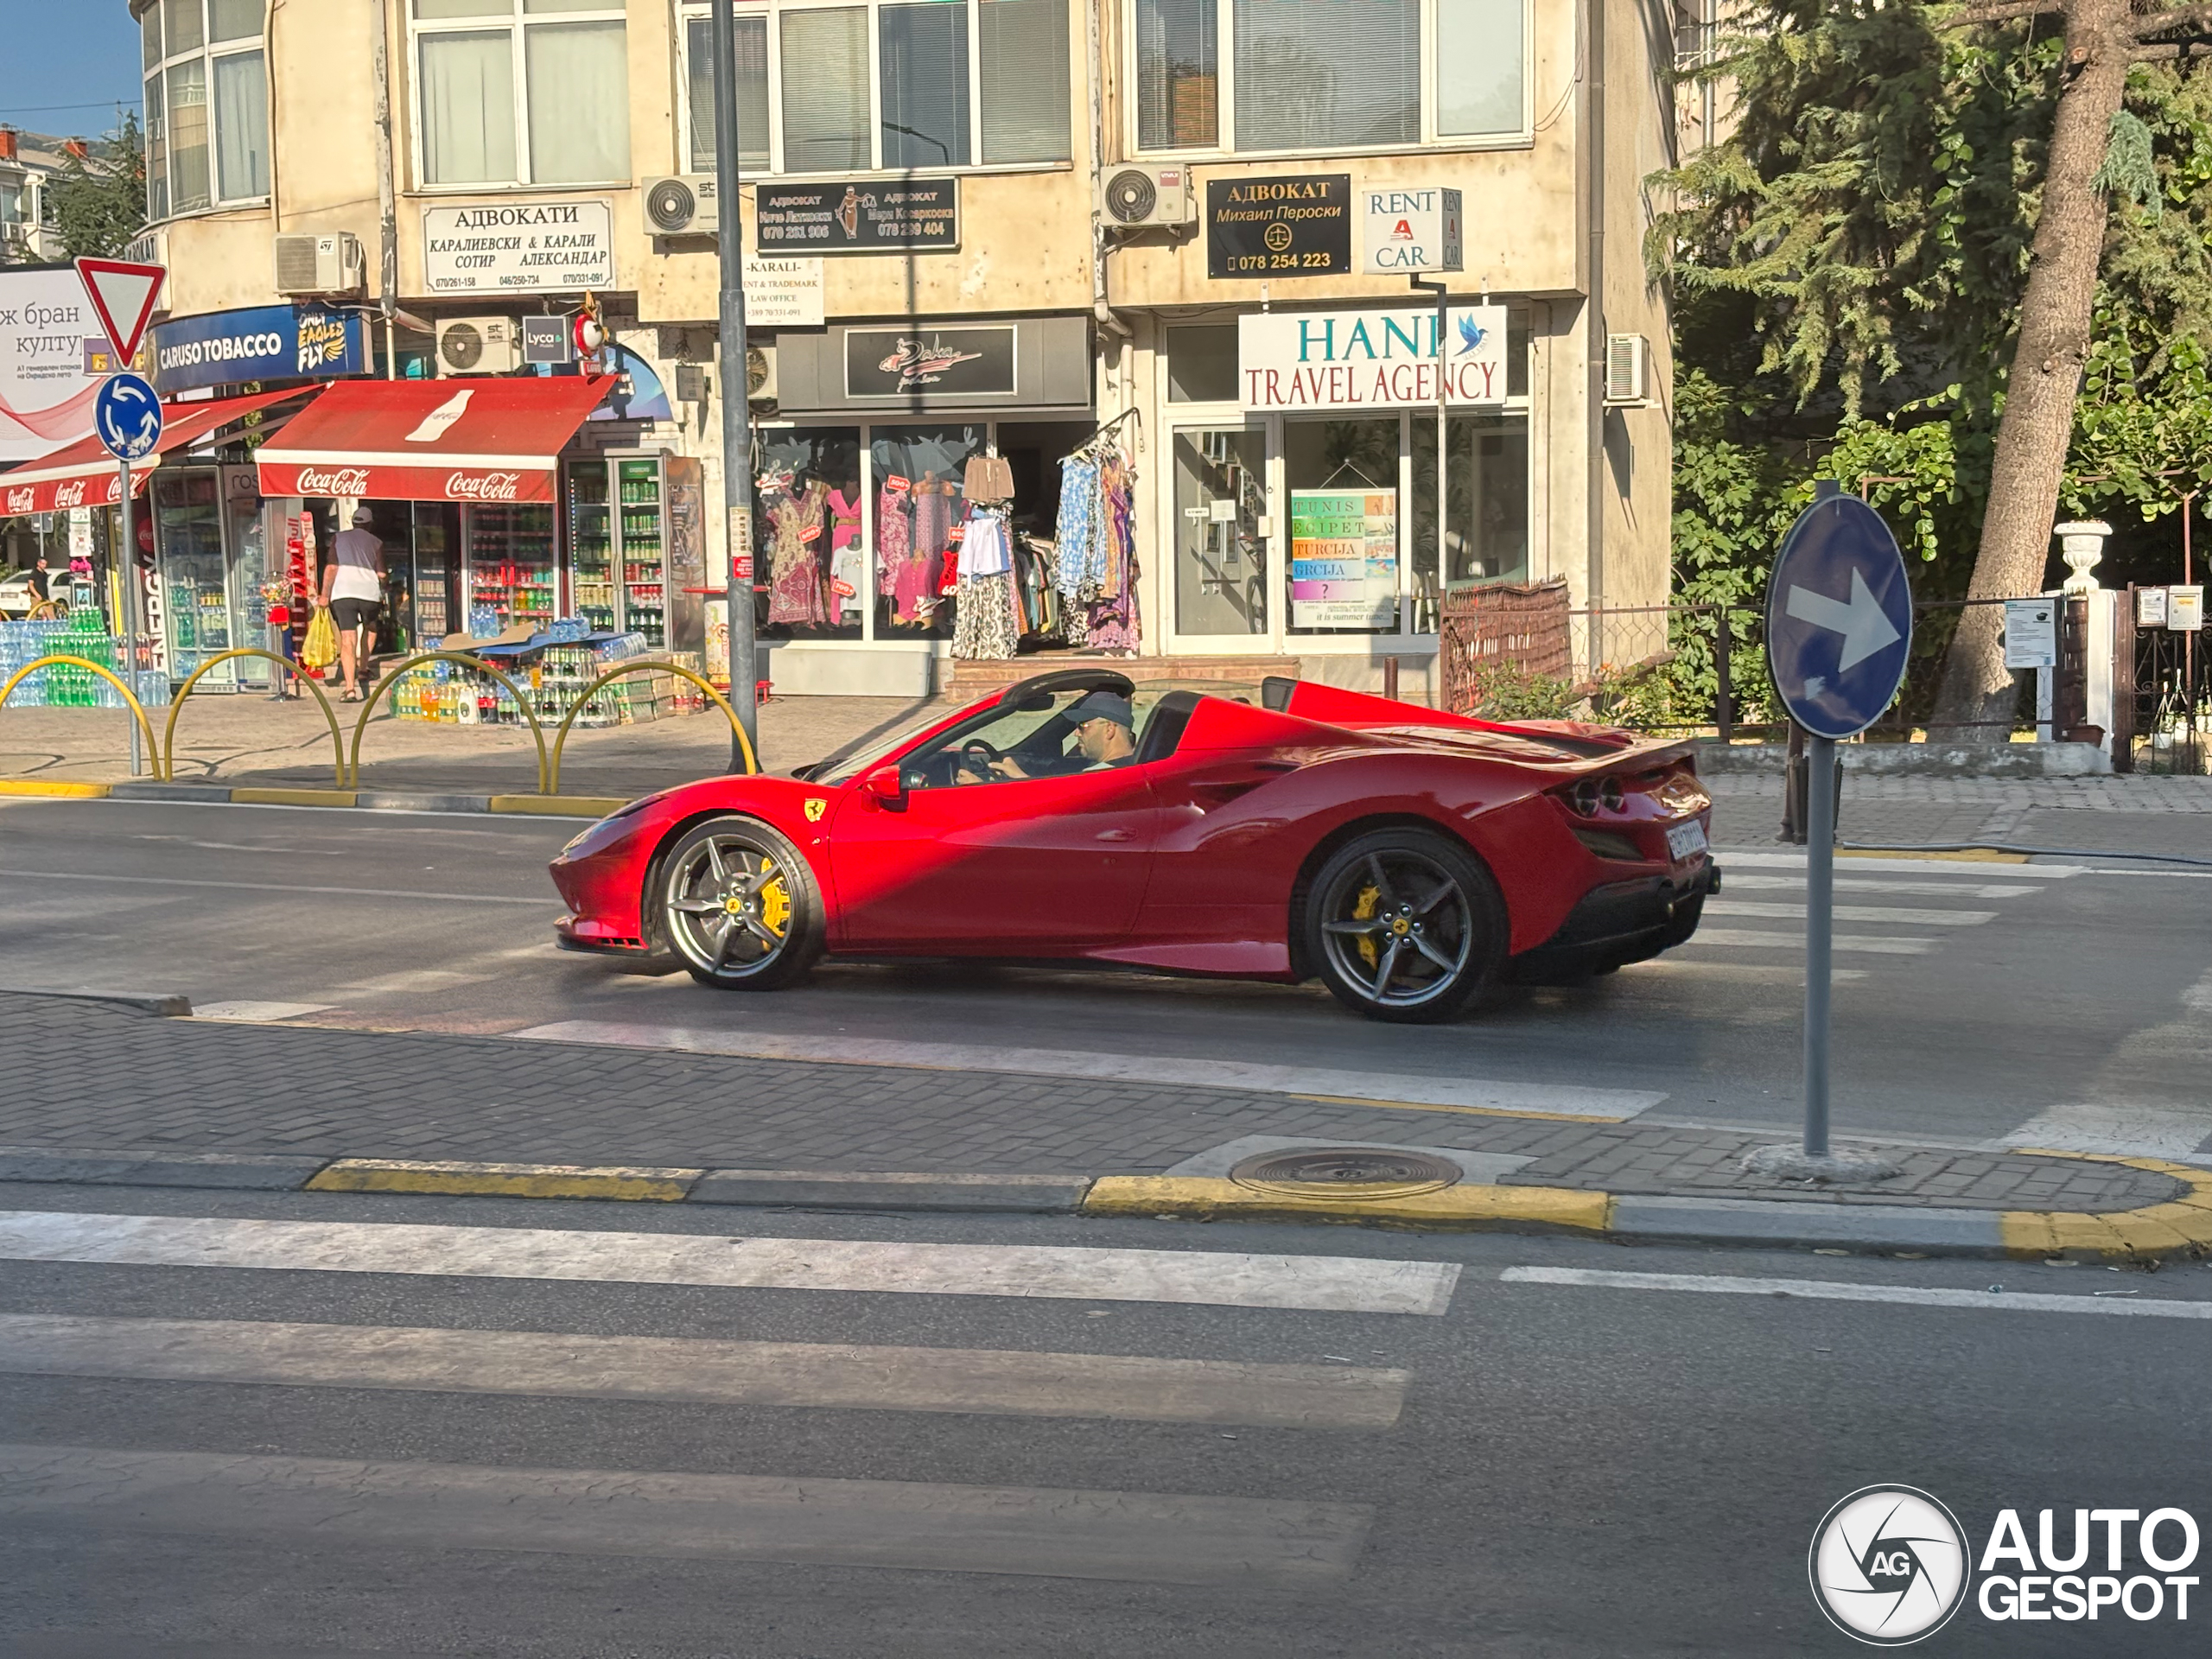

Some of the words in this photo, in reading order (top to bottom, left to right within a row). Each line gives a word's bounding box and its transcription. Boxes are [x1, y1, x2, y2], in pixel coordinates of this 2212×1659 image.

[768, 195, 823, 207] АДВОКАТ
[884, 192, 938, 204] АДВОКАТ
[1227, 181, 1331, 204] АДВОКАТ
[1443, 191, 1460, 213] RENT
[1370, 191, 1436, 214] RENT
[454, 207, 579, 231] АДВОКАТИ
[1217, 206, 1274, 224] Михаил
[1276, 205, 1342, 222] Пероски
[877, 223, 899, 237] 078
[924, 221, 945, 235] 404
[1389, 219, 1414, 240] A
[429, 237, 522, 252] КАРАЛИЕВСКИ
[528, 237, 537, 249] &
[544, 234, 596, 249] КАРАЛИ
[455, 255, 496, 269] СОТИР
[519, 251, 607, 267] АЛЕКСАНДАР
[1239, 257, 1266, 270] 078
[1270, 255, 1300, 270] 254
[1302, 253, 1331, 268] 223
[1376, 247, 1430, 269] CAR
[1445, 245, 1460, 264] CAR
[24, 302, 79, 330] бран
[299, 312, 326, 329] ONLY
[298, 321, 345, 347] EAGLES
[528, 332, 554, 346] Lyca
[160, 345, 202, 371] CARUSO
[204, 332, 282, 363] TOBACCO
[297, 345, 324, 373] FLY
[1245, 365, 1363, 406] TRAVEL
[1371, 361, 1497, 403] AGENCY
[297, 467, 371, 496] Coca-Cola
[445, 471, 520, 499] Coca-Cola
[1294, 501, 1354, 513] TUNIS
[1294, 522, 1364, 534] EGIPET
[1294, 543, 1356, 556] TURCIJA
[1294, 563, 1345, 575] GRCIJA
